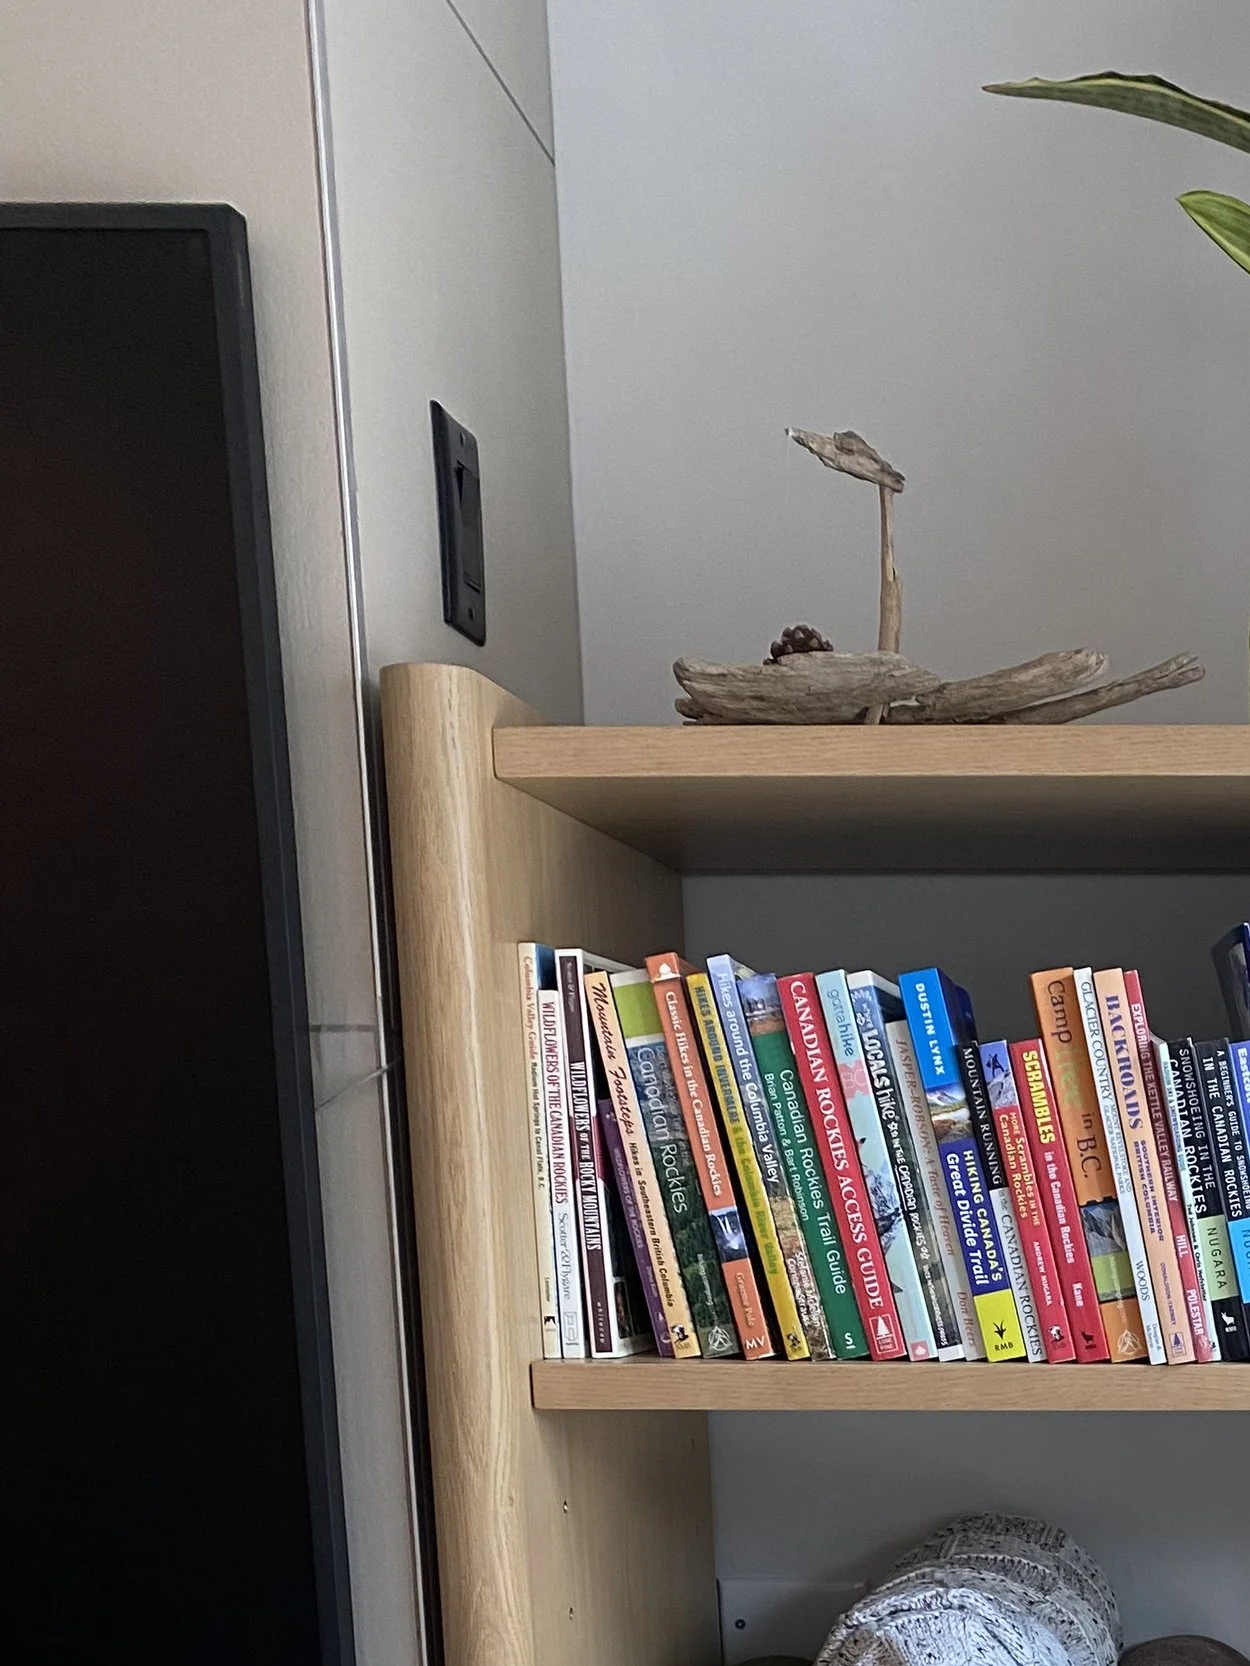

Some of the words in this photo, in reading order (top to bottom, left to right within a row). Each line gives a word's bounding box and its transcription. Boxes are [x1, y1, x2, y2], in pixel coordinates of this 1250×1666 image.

[524, 956, 535, 1000] Columbia
[717, 974, 736, 1008] Hikes
[525, 1003, 536, 1030] Valley
[665, 992, 686, 1030] Classic
[915, 983, 935, 1035] DUSTIN
[929, 1040, 945, 1076] LYNX
[1131, 1003, 1150, 1060] EXPLORING
[528, 1032, 537, 1060] Guide
[543, 1002, 558, 1073] WILDFLOWERS
[677, 1032, 694, 1064] Hikes
[728, 1010, 747, 1056] around
[1081, 981, 1099, 1039] GLACIER
[1091, 1040, 1112, 1102] COUNTRY
[592, 983, 616, 1060] Mountain
[609, 1066, 636, 1136] Footsteps
[683, 1065, 694, 1077] in
[740, 1058, 756, 1080] the
[1105, 994, 1143, 1130] BACKROADS
[1143, 1061, 1154, 1081] THE
[1203, 1057, 1215, 1071] IN
[548, 1075, 560, 1087] OF
[548, 1089, 561, 1109] THE
[687, 1079, 701, 1098] the
[1022, 1050, 1056, 1144] SCRAMBLES
[1147, 1082, 1161, 1119] KETTLE
[1179, 1049, 1205, 1139] SNOWSHOEING
[1207, 1078, 1222, 1100] THE
[1218, 1061, 1235, 1107] BEGINNER'S
[637, 1047, 671, 1140] Canadian
[660, 1143, 689, 1213] Rockies
[692, 1099, 712, 1151] Canadian
[745, 1082, 770, 1142] Columbia
[962, 1047, 987, 1120] MOUNTAIN
[979, 1123, 1002, 1185] RUNNING
[1009, 1112, 1020, 1136] MORE
[1228, 1111, 1241, 1137] GUIDE
[549, 1110, 566, 1159] CANADIAN
[629, 1143, 640, 1166] Hikes
[790, 981, 829, 1083] CANADIAN
[815, 1088, 849, 1170] ROCKIES
[838, 1175, 866, 1243] ACCESS
[856, 1248, 884, 1310] GUIDE
[1152, 1120, 1169, 1158] VALLEY
[1198, 1145, 1209, 1160] IN
[1212, 1106, 1231, 1162] CANADIAN
[1234, 1141, 1244, 1151] TO
[635, 1167, 643, 1176] in
[704, 1153, 723, 1196] Rockies
[762, 1144, 780, 1183] Valley
[945, 1153, 966, 1197] Great
[999, 1114, 1017, 1169] Canadian
[1012, 1173, 1029, 1219] Rockies
[1015, 1137, 1035, 1197] Scrambles
[1044, 1151, 1054, 1162] in
[1046, 1163, 1059, 1180] the
[1203, 1165, 1215, 1189] THE
[553, 1162, 567, 1204] ROCKIES
[779, 1070, 809, 1143] Canadian
[799, 1148, 825, 1209] Rockies
[817, 1213, 836, 1246] Trail
[827, 1250, 848, 1294] Guide
[1161, 1159, 1178, 1202] RAILWAY
[1223, 1170, 1242, 1218] ROCKIES
[638, 1180, 657, 1235] Southeastern
[957, 1200, 980, 1247] Divide
[1028, 1200, 1036, 1210] IN
[1031, 1212, 1040, 1226] THE
[1049, 1181, 1066, 1225] Canadian
[651, 1238, 665, 1266] British
[1059, 1226, 1076, 1264] Rockies
[1175, 1234, 1188, 1258] HILL
[1206, 1227, 1228, 1290] NUGARA
[659, 1268, 675, 1307] Columbia
[968, 1249, 990, 1285] Trail
[1033, 1241, 1047, 1274] ANDREW
[1040, 1275, 1053, 1306] NUGARA
[1135, 1260, 1150, 1301] WOODS
[735, 1272, 749, 1306] Graeme
[743, 1307, 756, 1326] Pole
[1186, 1289, 1204, 1336] POLESTAR
